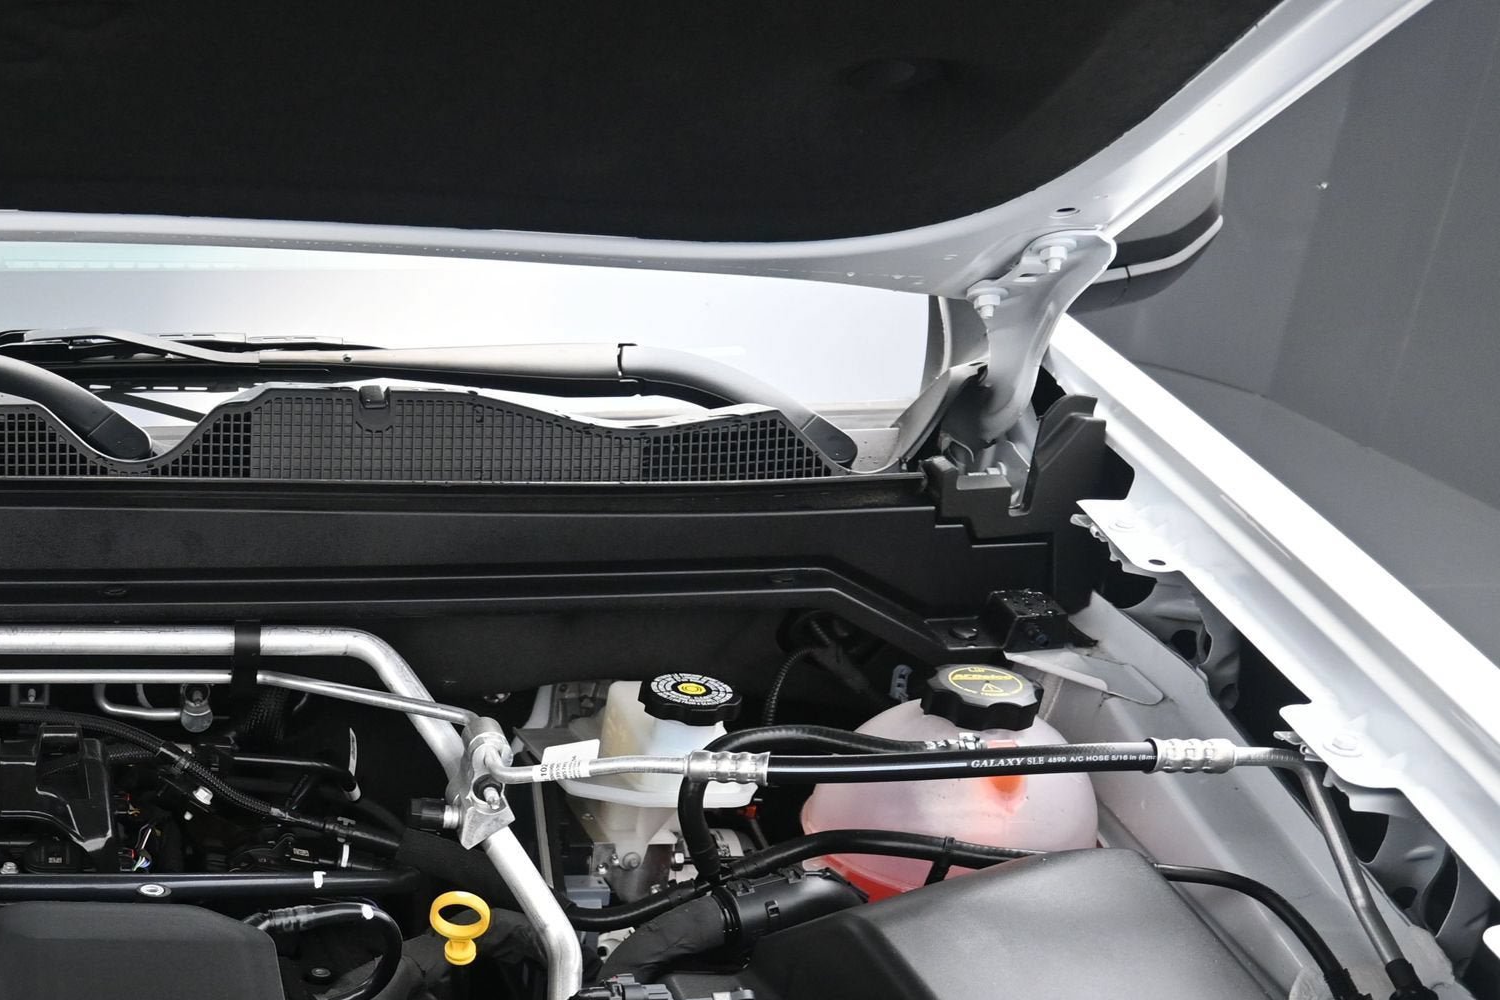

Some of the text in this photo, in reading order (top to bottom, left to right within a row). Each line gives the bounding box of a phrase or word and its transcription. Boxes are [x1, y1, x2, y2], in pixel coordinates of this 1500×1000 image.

[971, 758, 1025, 768] GALAXY
[1026, 756, 1045, 766] SLE
[1069, 755, 1084, 763] A/C
